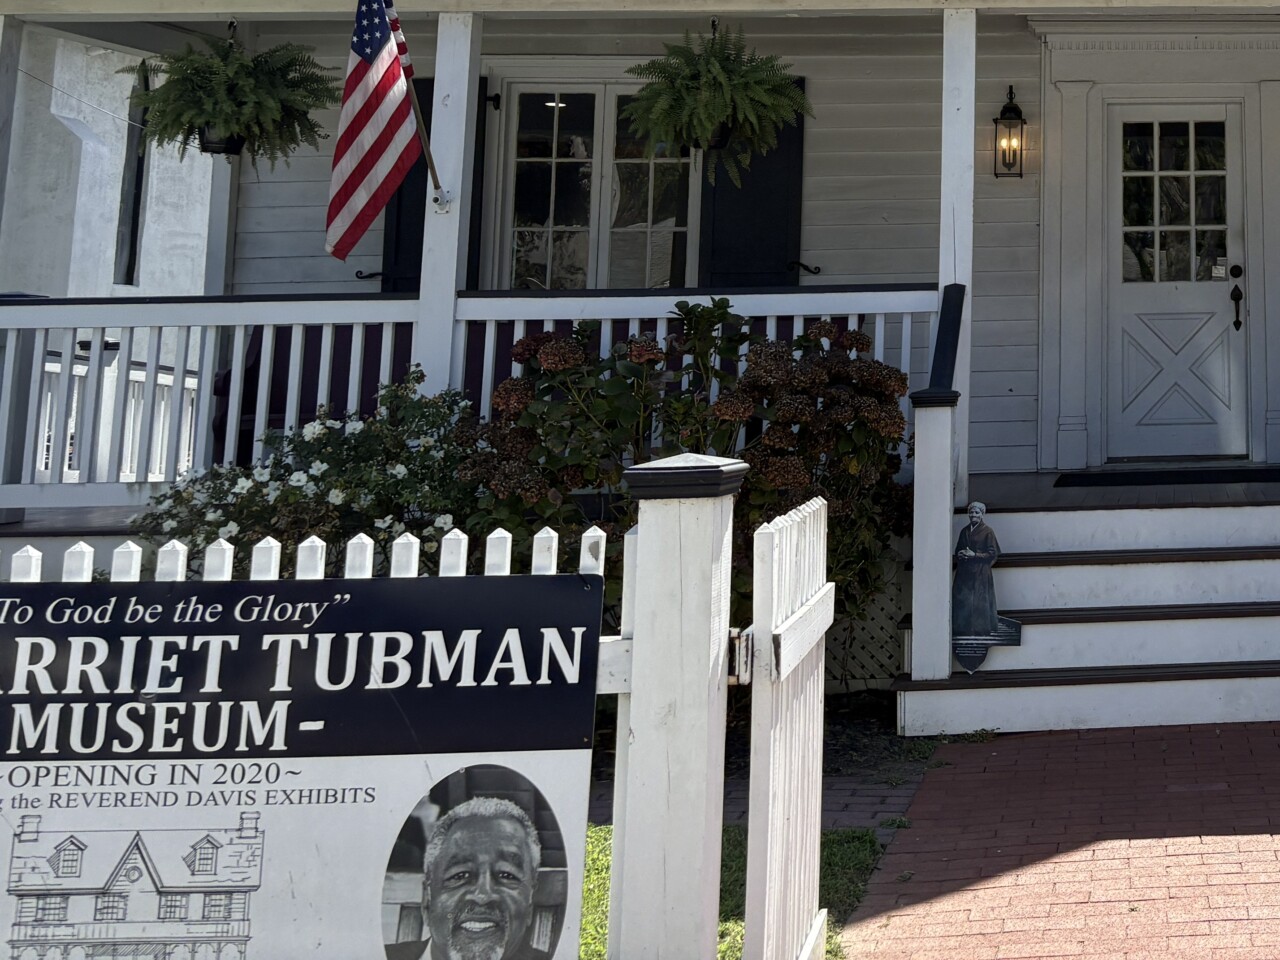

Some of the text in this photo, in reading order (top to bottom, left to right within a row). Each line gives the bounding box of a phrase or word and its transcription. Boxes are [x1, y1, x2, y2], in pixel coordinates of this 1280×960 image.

[45, 596, 118, 624] God
[124, 596, 163, 623] be
[173, 596, 223, 623] the
[0, 627, 586, 694] RRIET TUBMAN
[169, 763, 204, 785] IN
[11, 793, 42, 809] the
[47, 791, 179, 808] REVEREND
[186, 790, 257, 806] DAVIS
[264, 787, 376, 806] EXHIBITS
